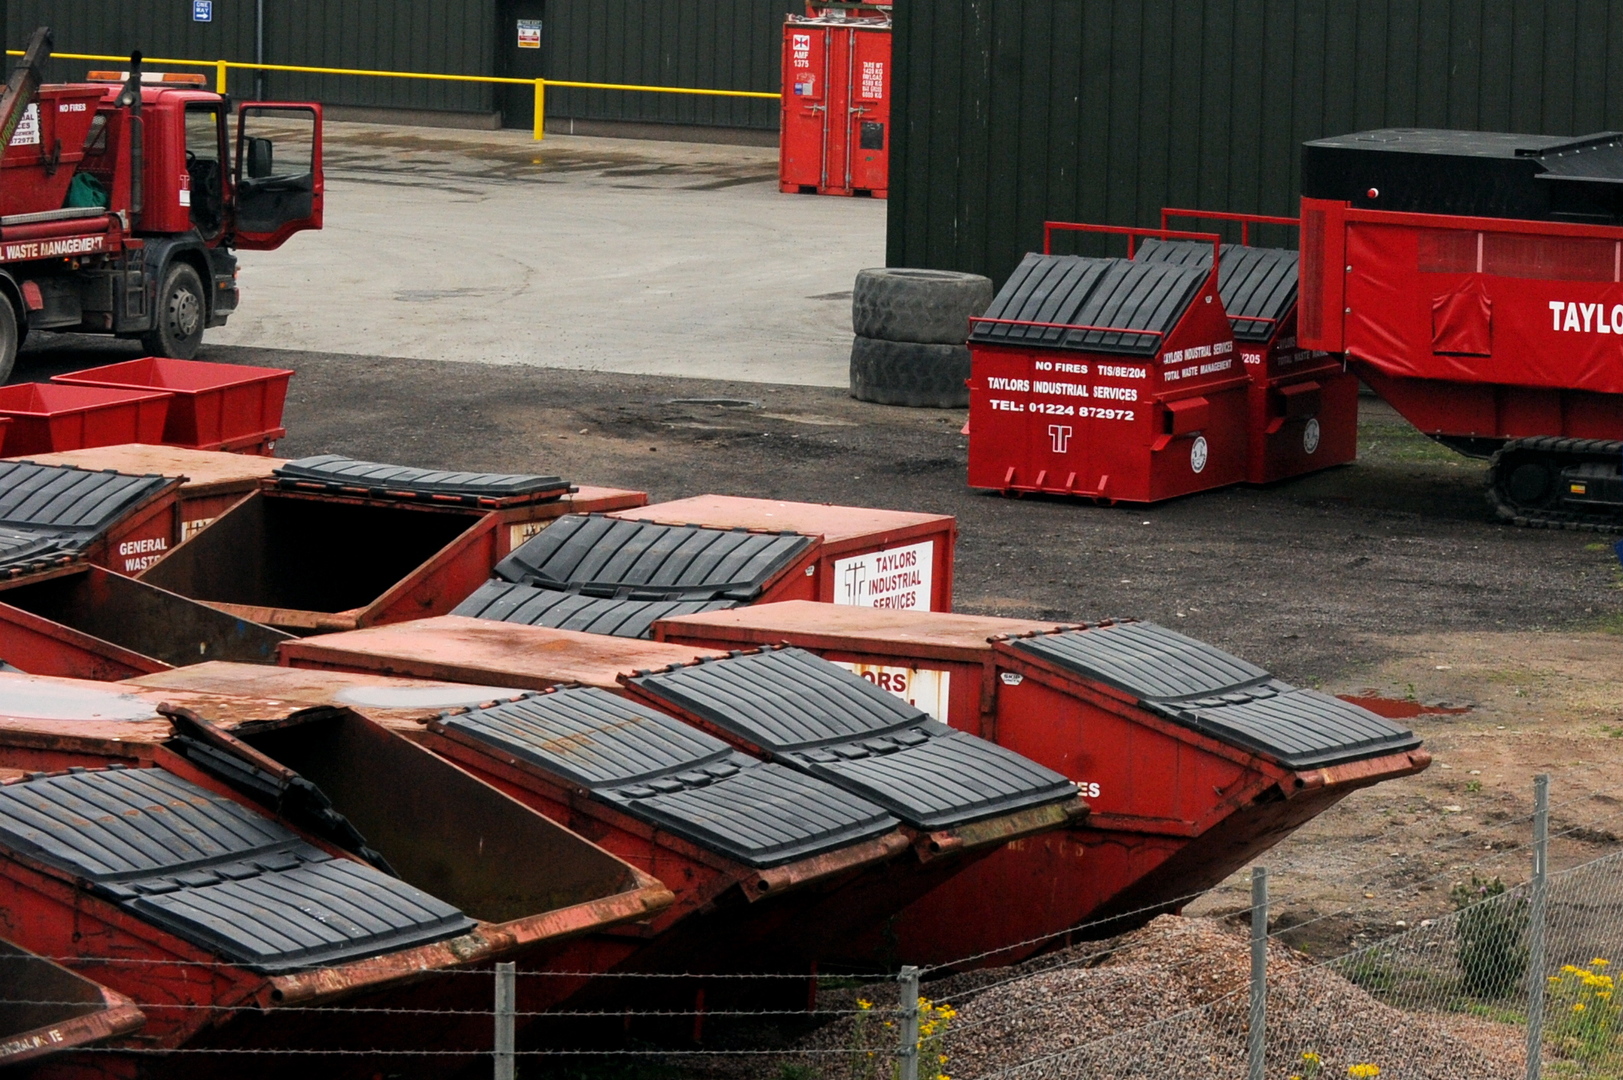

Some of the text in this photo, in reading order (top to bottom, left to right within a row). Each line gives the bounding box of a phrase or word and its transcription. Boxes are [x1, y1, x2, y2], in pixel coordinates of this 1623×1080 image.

[793, 60, 809, 68] 1375
[59, 103, 86, 112] NO FIRES
[7, 243, 38, 259] WASTE
[1184, 345, 1212, 360] INDUSTRIAL
[1213, 341, 1233, 355] SERVICES
[1035, 361, 1146, 379] NO FIRES TIS/8E/204
[1164, 359, 1232, 382] TOTAL WASTE MANAGEMENT
[987, 377, 1137, 401] TAYLORS INDUSTRIAL SERVICES
[989, 399, 1134, 421] TEL: 01224 872972
[119, 537, 167, 556] GENERAL
[876, 550, 917, 573] TAYLORS
[868, 570, 921, 596] INDUSTRIAL
[873, 591, 916, 610] SERVICES
